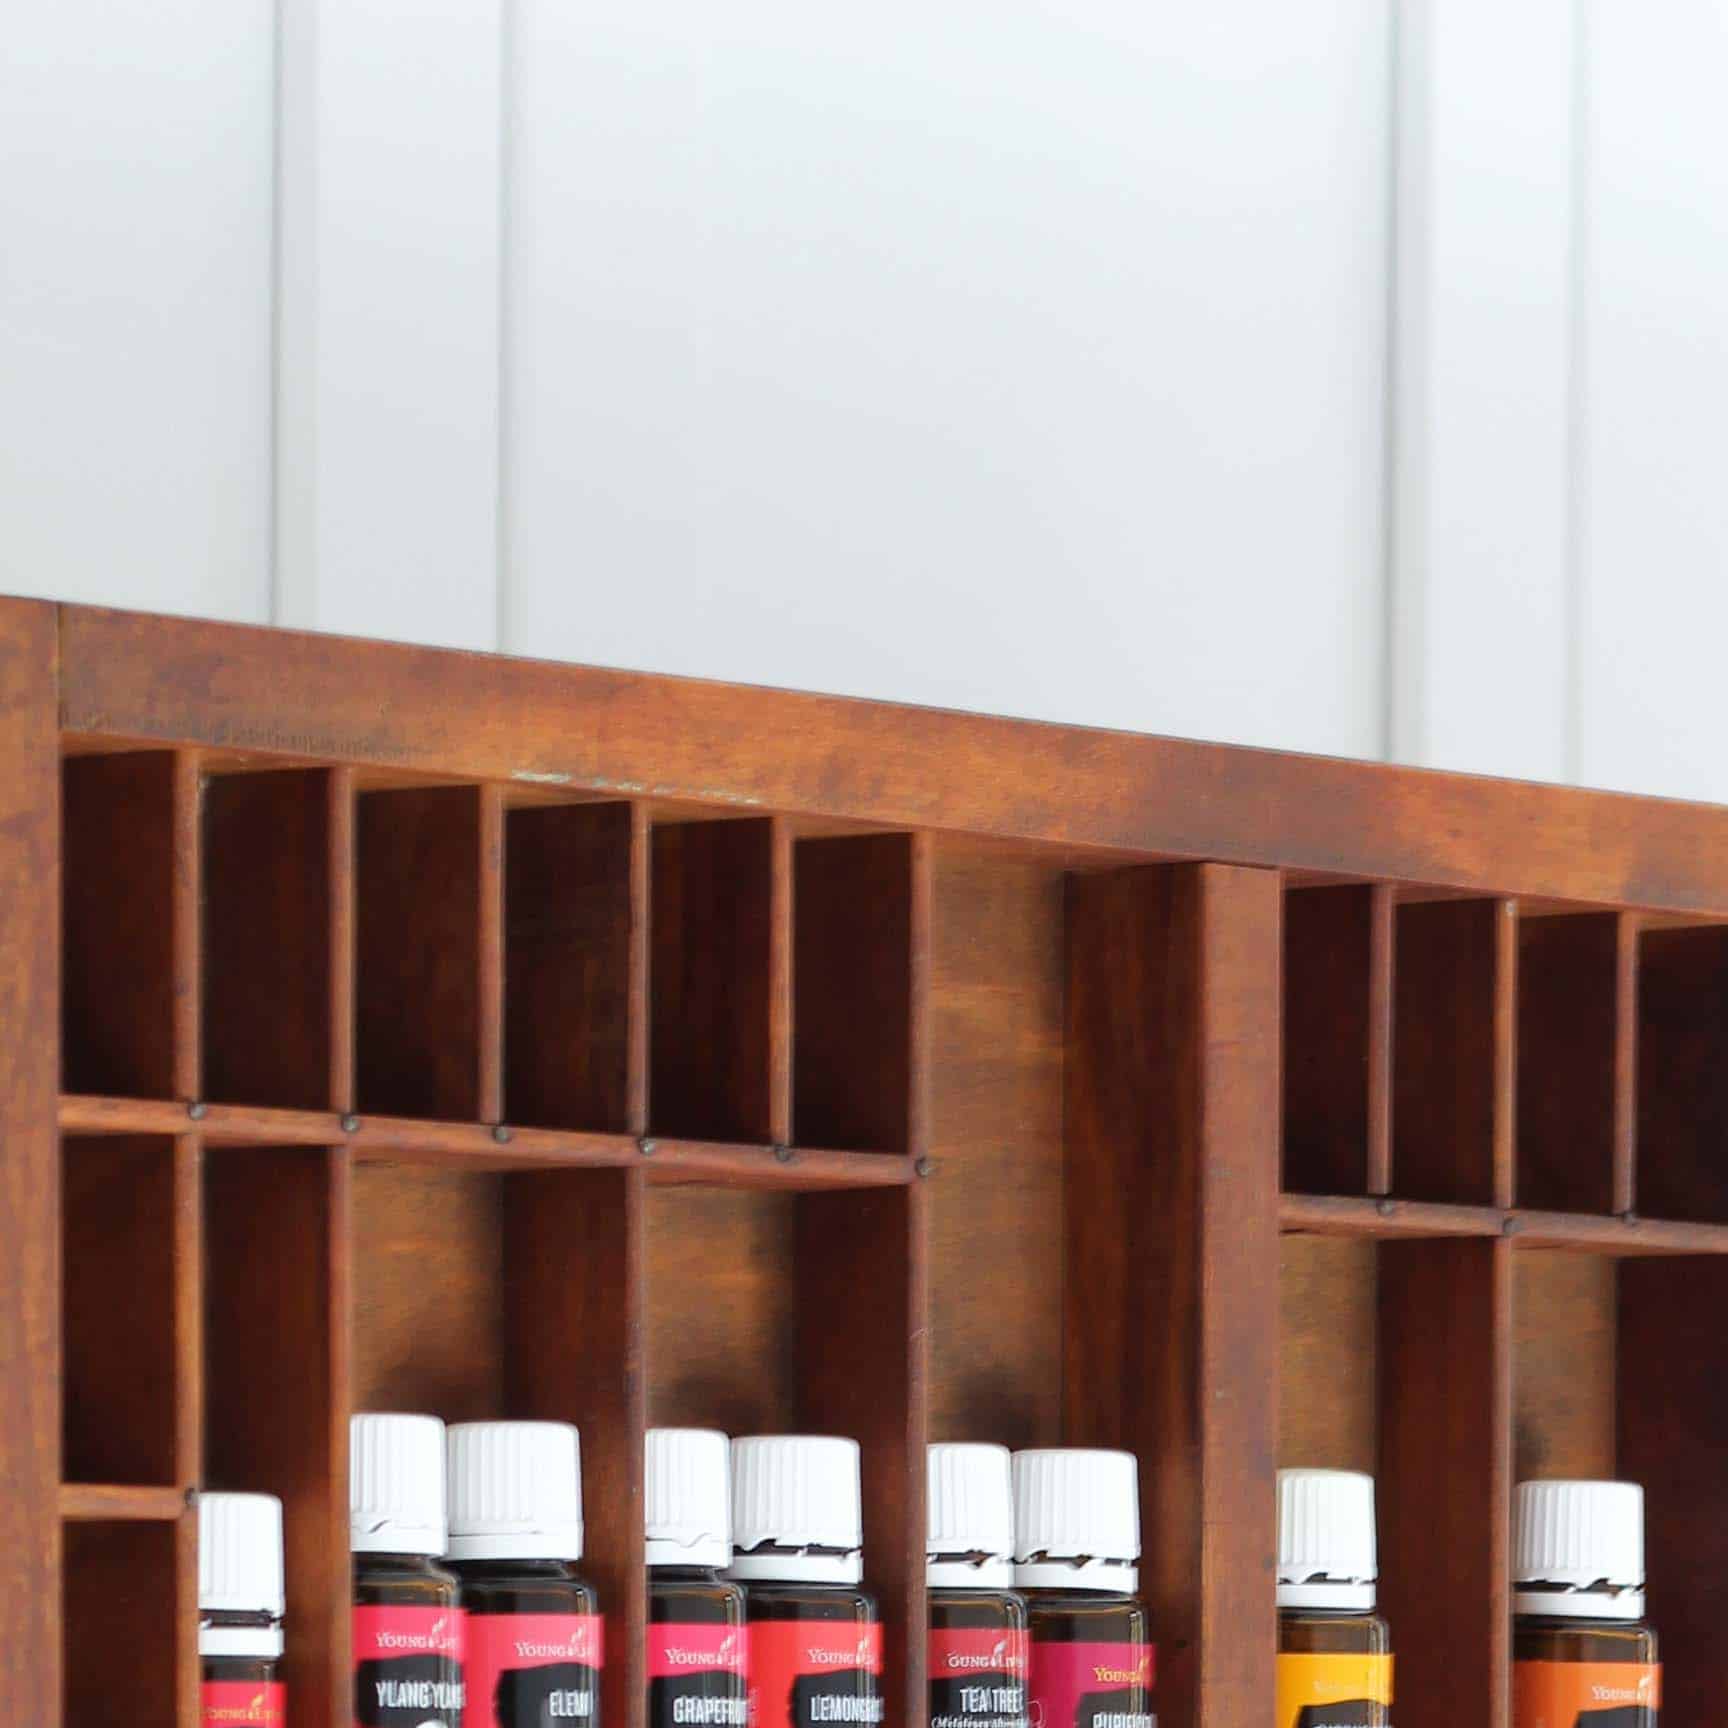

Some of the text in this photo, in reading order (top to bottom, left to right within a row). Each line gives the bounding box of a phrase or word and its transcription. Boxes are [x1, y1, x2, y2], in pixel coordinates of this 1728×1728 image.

[376, 1682, 429, 1708] YLANG
[550, 1689, 594, 1717] ELEMI
[960, 1687, 1023, 1713] TEA TREE
